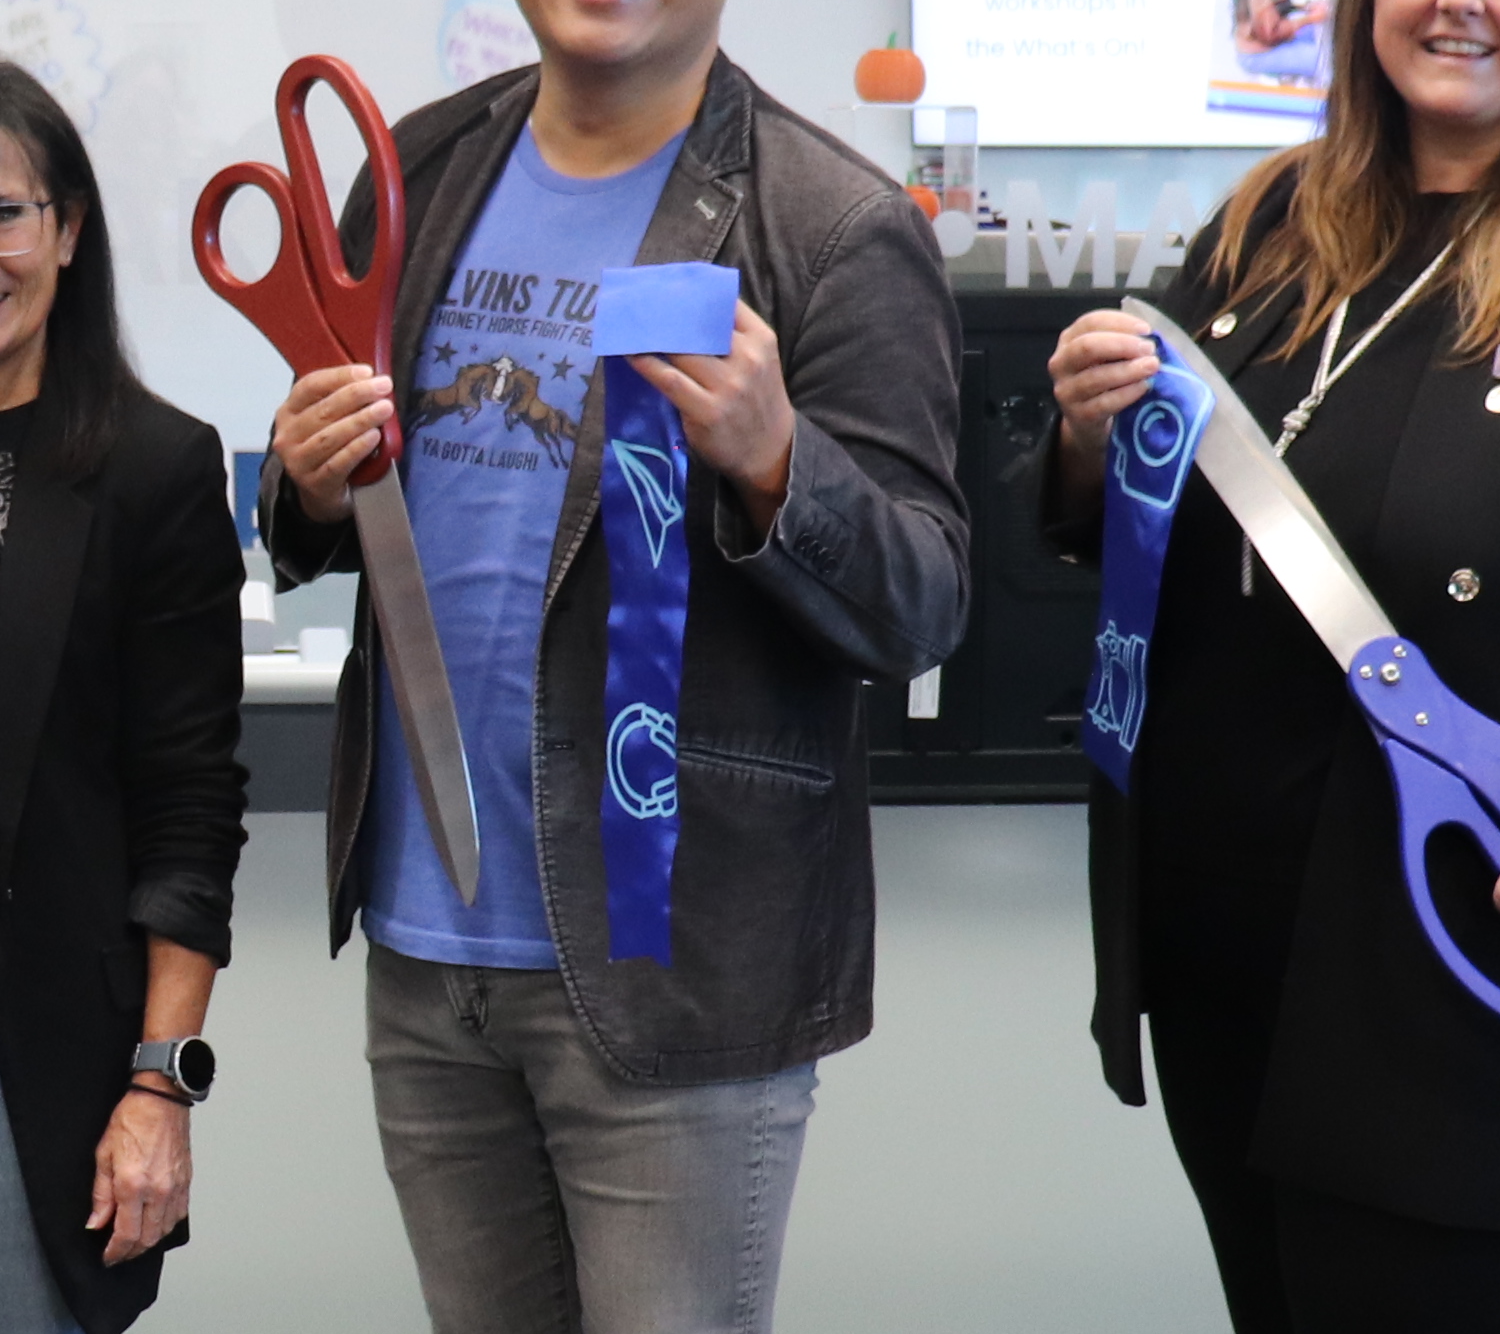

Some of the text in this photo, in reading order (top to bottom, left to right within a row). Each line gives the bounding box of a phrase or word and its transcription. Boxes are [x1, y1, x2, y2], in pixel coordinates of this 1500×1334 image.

[966, 37, 1005, 59] the
[1013, 37, 1096, 58] What's
[437, 309, 594, 347] HONEY HORSE FIGHT FIE
[441, 441, 485, 465] GOTTA
